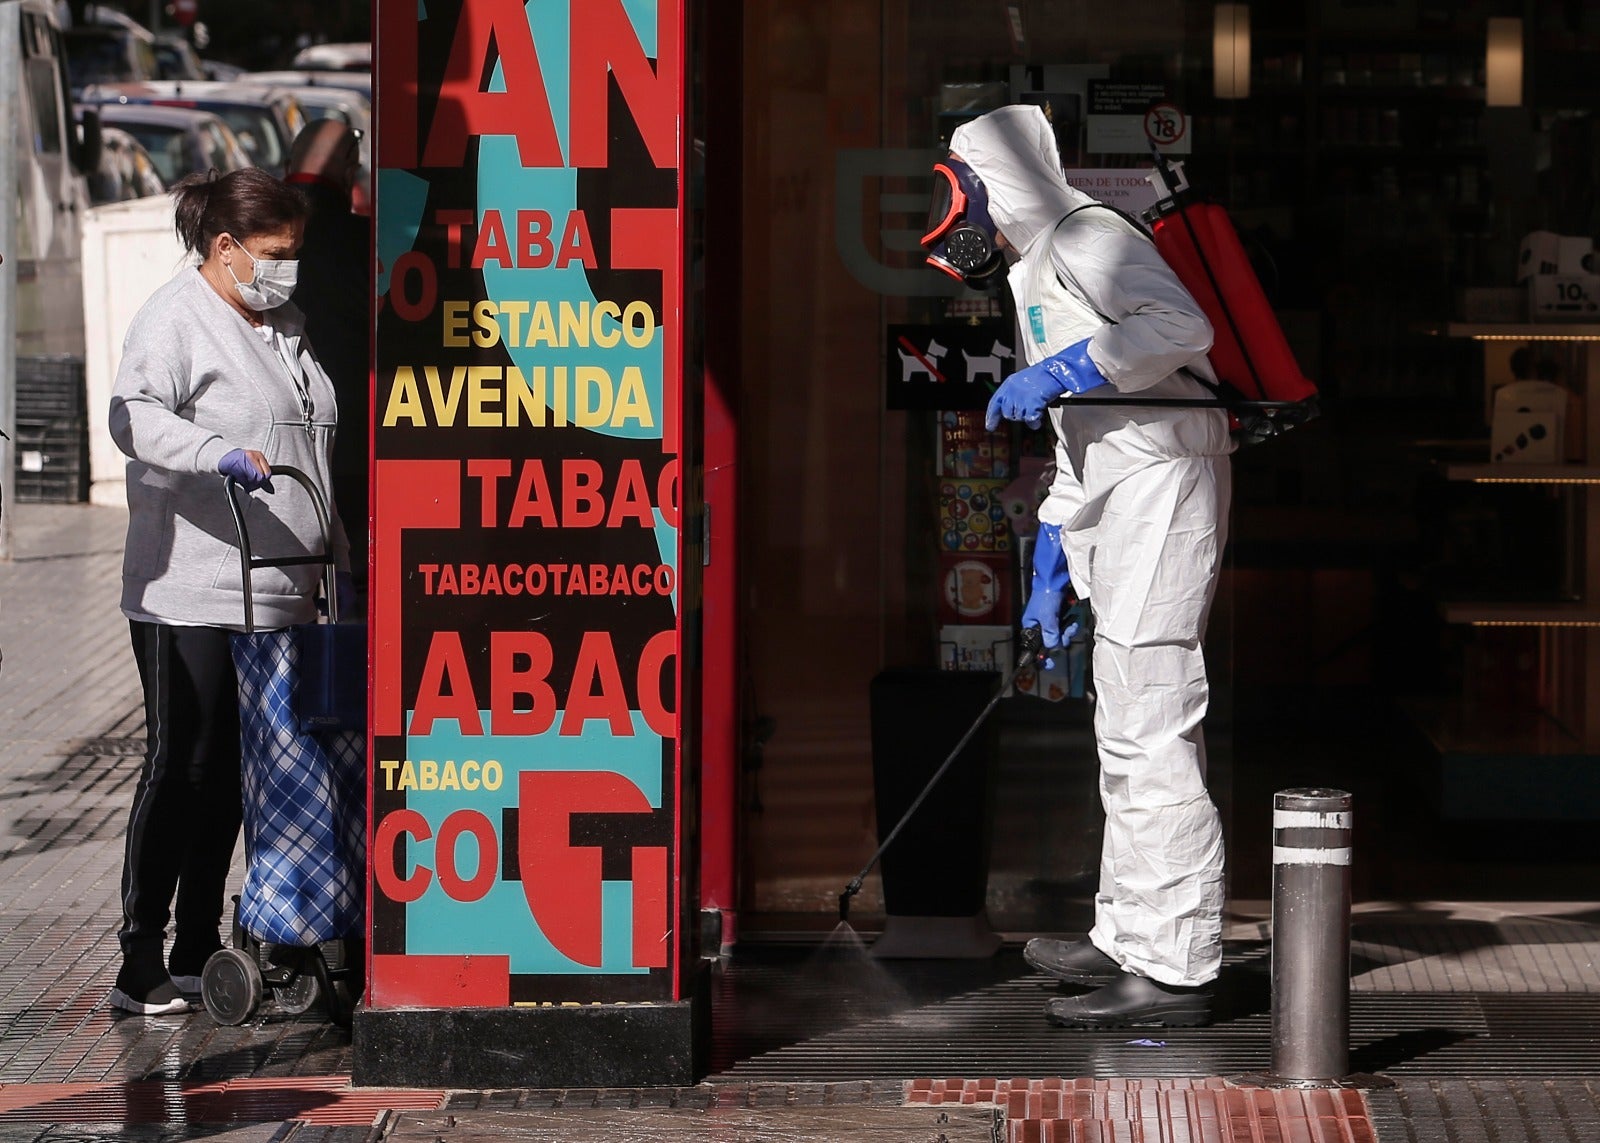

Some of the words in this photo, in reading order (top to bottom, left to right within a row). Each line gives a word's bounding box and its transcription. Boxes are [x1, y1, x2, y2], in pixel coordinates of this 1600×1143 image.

[1153, 119, 1175, 137] 18
[1096, 177, 1111, 187] DE
[436, 209, 598, 269] TABA
[443, 300, 655, 348] ESTANCO
[382, 366, 655, 427] AVENIDA
[418, 563, 676, 597] TABACOTABACO
[380, 760, 503, 790] TABACO
[374, 809, 499, 903] CO
